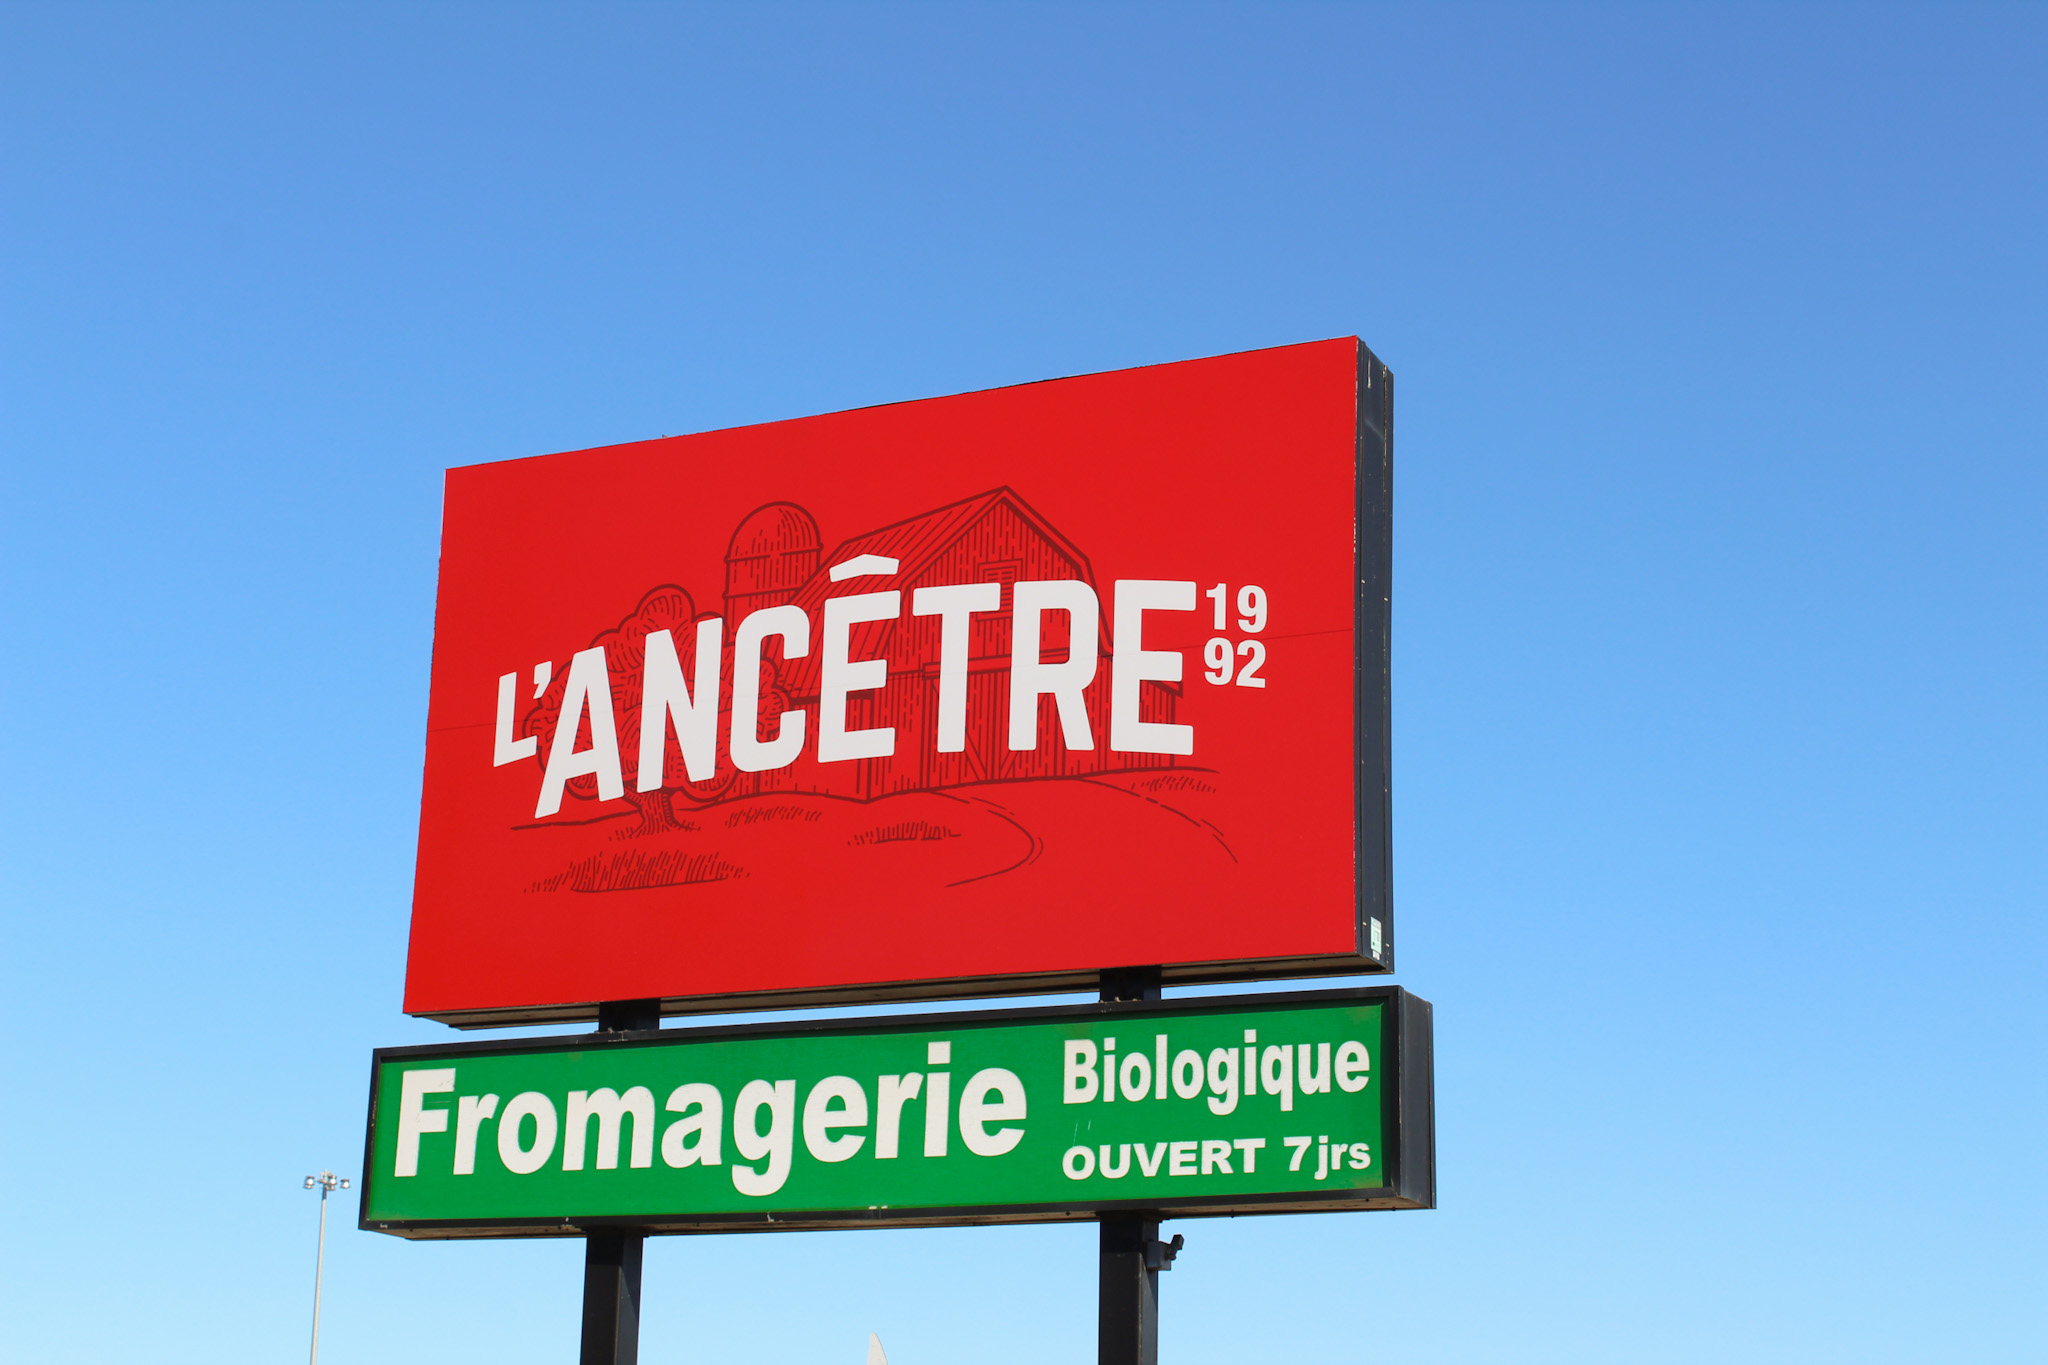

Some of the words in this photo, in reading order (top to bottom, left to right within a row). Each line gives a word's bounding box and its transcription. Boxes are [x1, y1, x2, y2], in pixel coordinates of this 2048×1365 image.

[1205, 582, 1268, 635] 19
[1203, 637, 1267, 689] 92
[1063, 1028, 1370, 1116] Biologique
[394, 1041, 1027, 1197] Fromagerie
[1062, 1138, 1266, 1181] OUVERT
